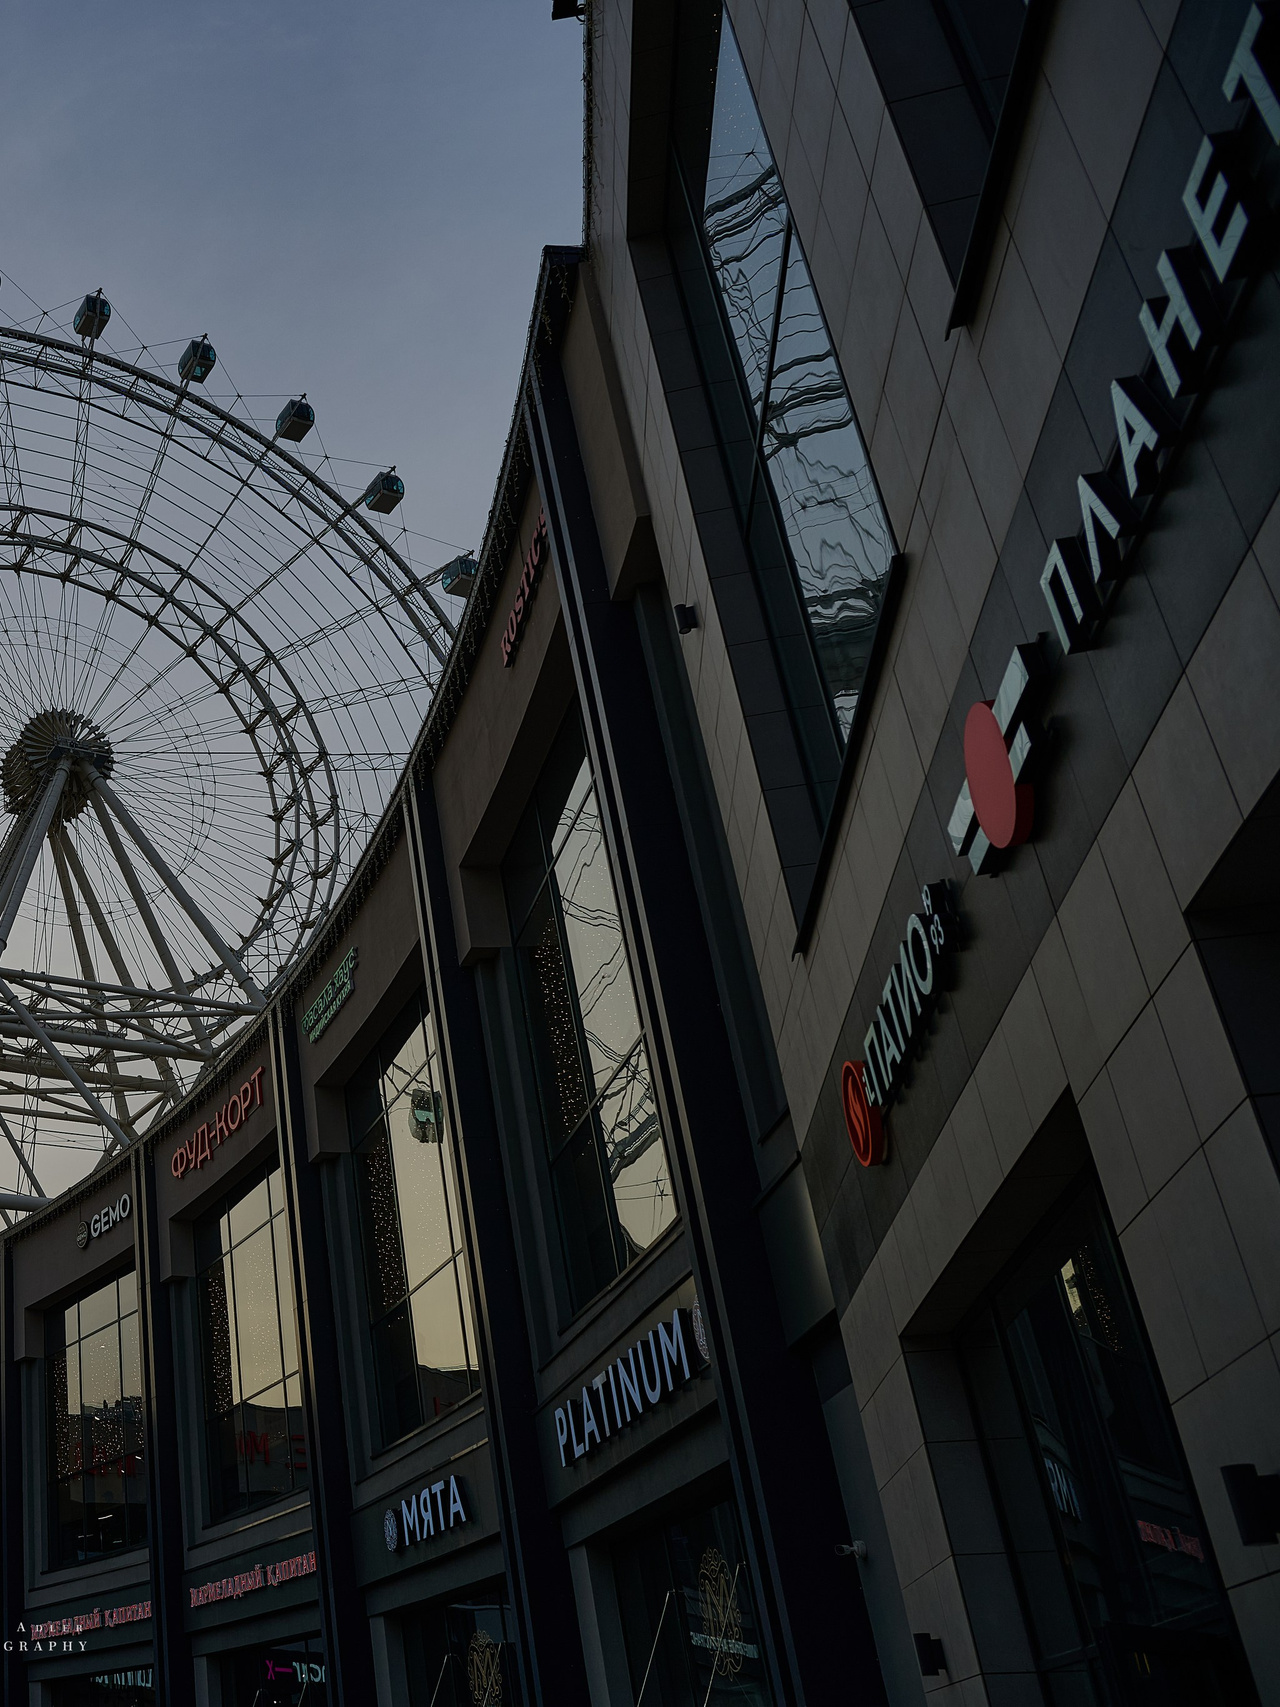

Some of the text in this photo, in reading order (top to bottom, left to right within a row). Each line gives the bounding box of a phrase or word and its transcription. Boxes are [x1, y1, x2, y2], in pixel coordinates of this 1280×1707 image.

[171, 1066, 265, 1178] ФУД-КОРТ
[90, 1193, 131, 1238] GEMO
[554, 1308, 691, 1468] PLATINUM
[401, 1474, 467, 1546] МЯТА
[190, 1551, 317, 1608] МАРМЕЛАДНЫЙ КАПИТАН
[104, 1600, 152, 1628] КАПИТАН
